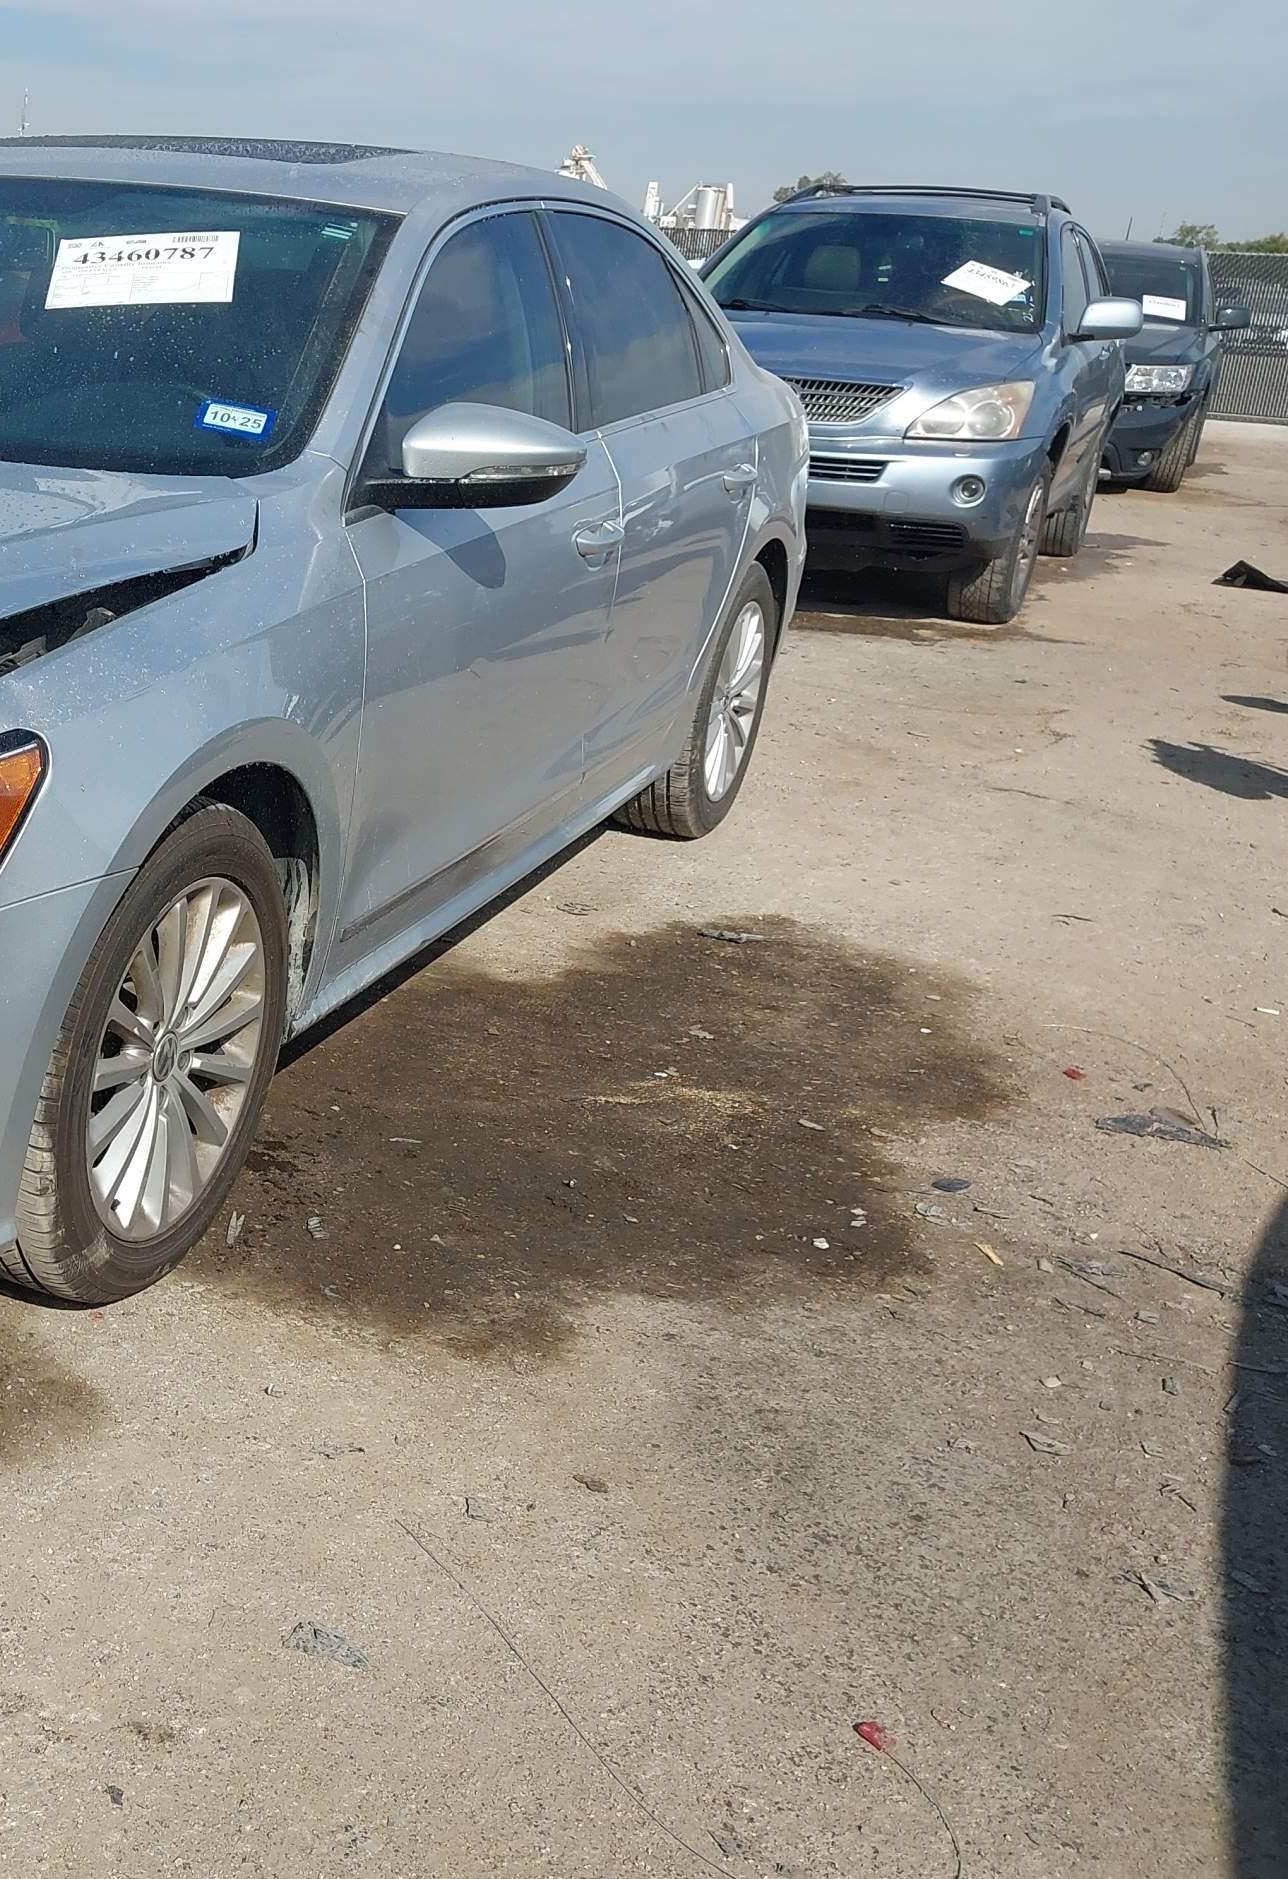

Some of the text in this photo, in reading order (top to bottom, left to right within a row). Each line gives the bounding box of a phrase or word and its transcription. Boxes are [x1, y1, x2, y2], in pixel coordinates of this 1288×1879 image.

[73, 246, 215, 265] 43460787
[210, 410, 263, 429] 10 25
